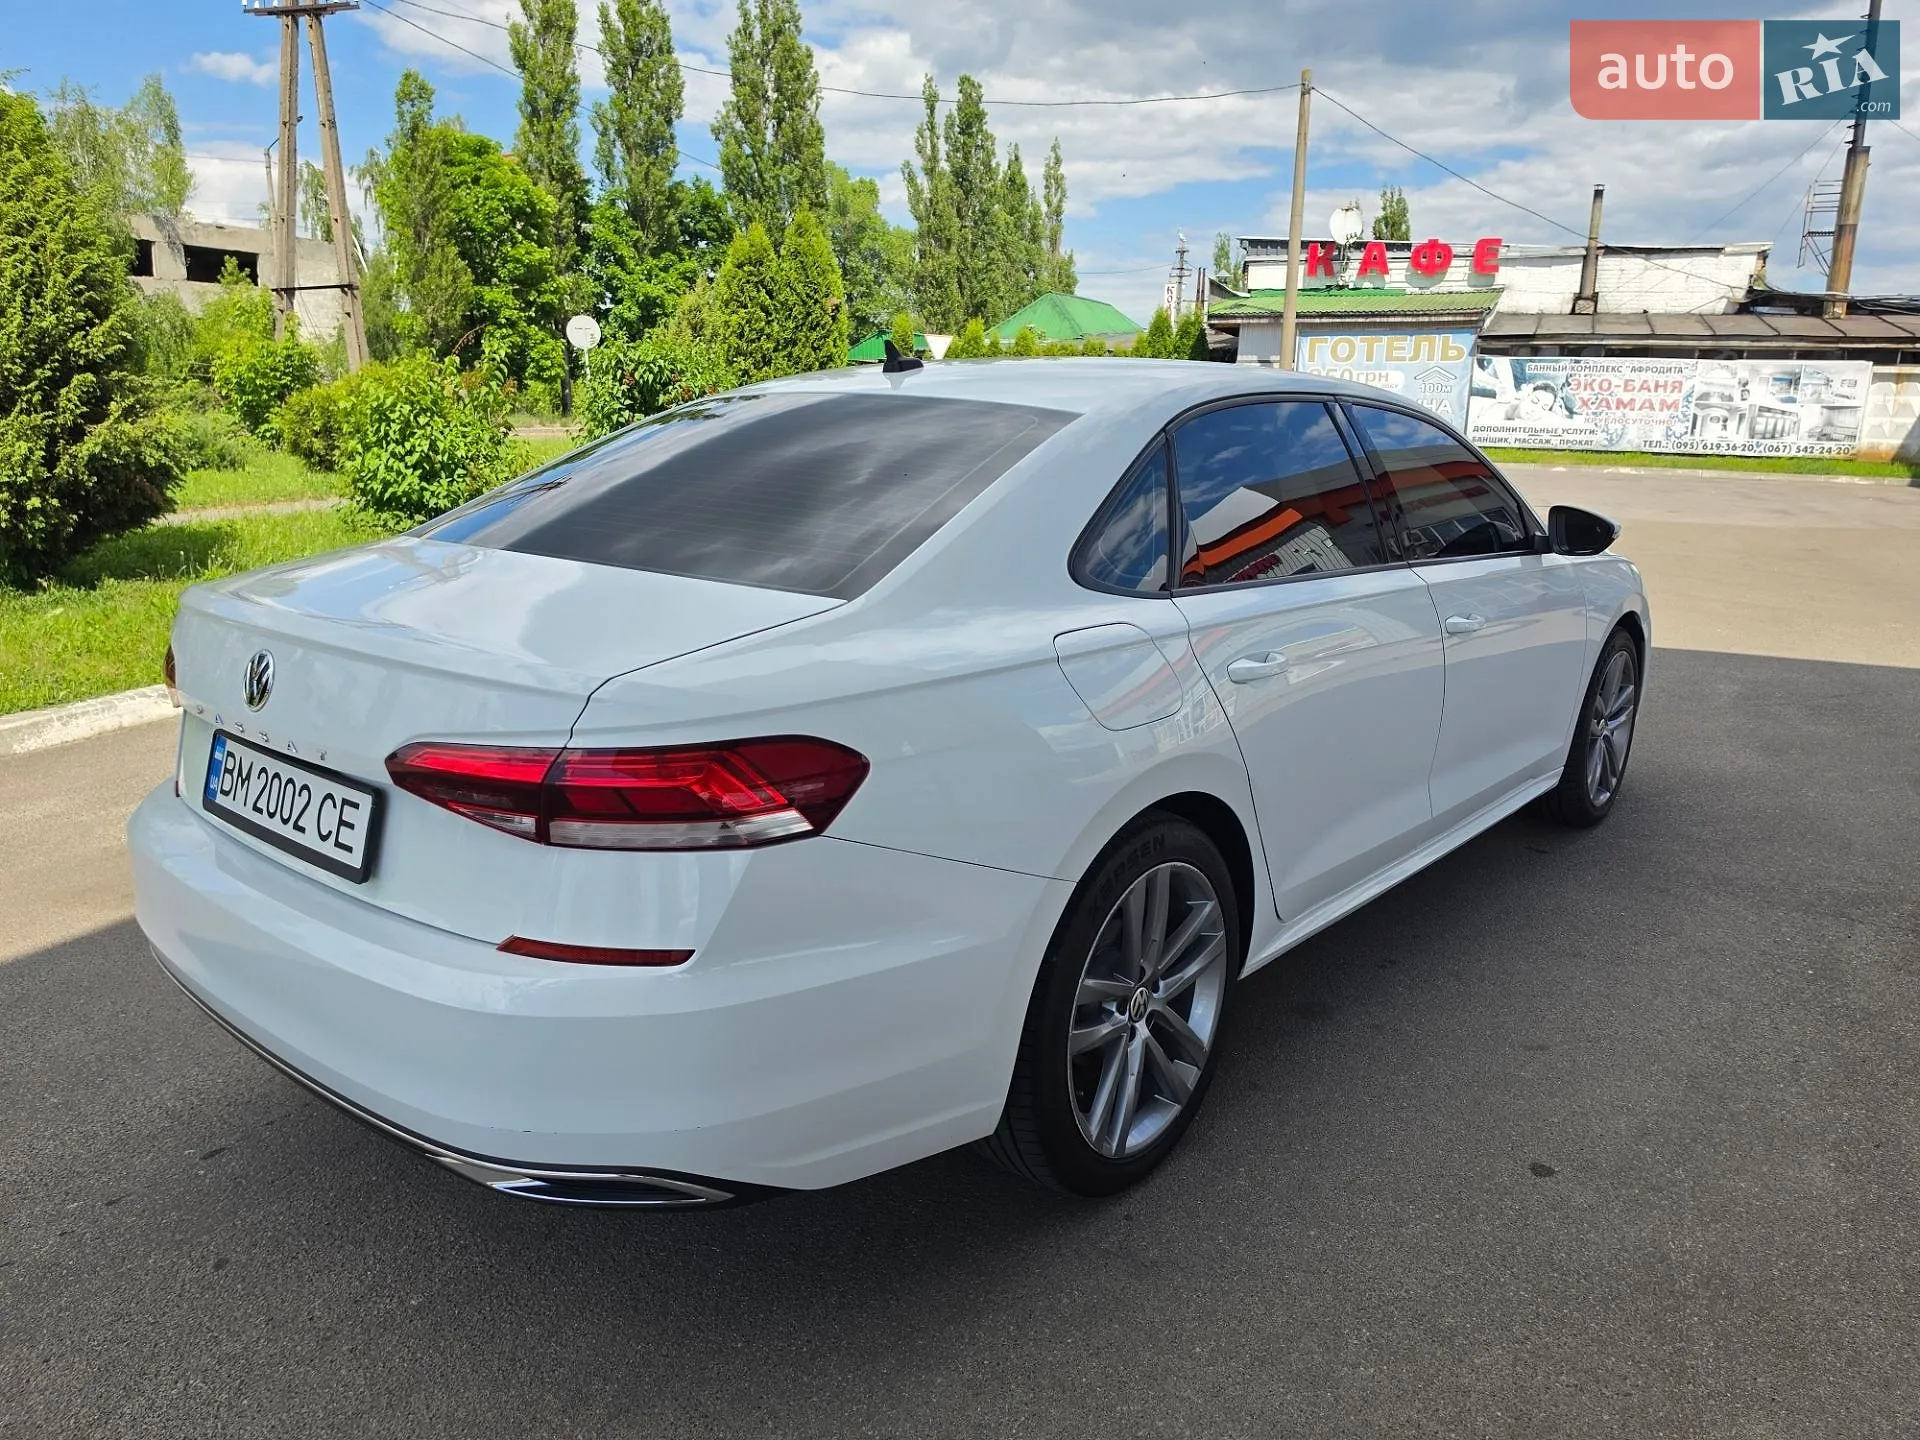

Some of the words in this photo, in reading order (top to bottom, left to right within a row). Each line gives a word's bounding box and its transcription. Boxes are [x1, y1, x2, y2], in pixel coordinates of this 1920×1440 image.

[1306, 236, 1503, 278] КАФЕ
[1307, 335, 1467, 363] ГОТЕЛЬ
[1527, 363, 1568, 372] БАННЫЙ
[1571, 364, 1623, 373] КОМПЛЕКС
[1626, 365, 1689, 375] "АФРОДИТА"
[1570, 378, 1684, 393] ЭКО-БАНЯ
[1576, 396, 1680, 412] ХАМАМ
[1472, 425, 1558, 434] ДОПОЛНИТЕЛЬНЫЕ
[1561, 428, 1598, 436] УСЛУГИ:
[1559, 439, 1593, 447] ПРОКАТ
[1643, 440, 1669, 449] ТЕЛ.:
[1671, 440, 1699, 450] (095)
[1702, 442, 1757, 453] 619-36-20,
[1763, 443, 1792, 454] (067)
[252, 766, 313, 835] 2002
[316, 792, 360, 854] CE
